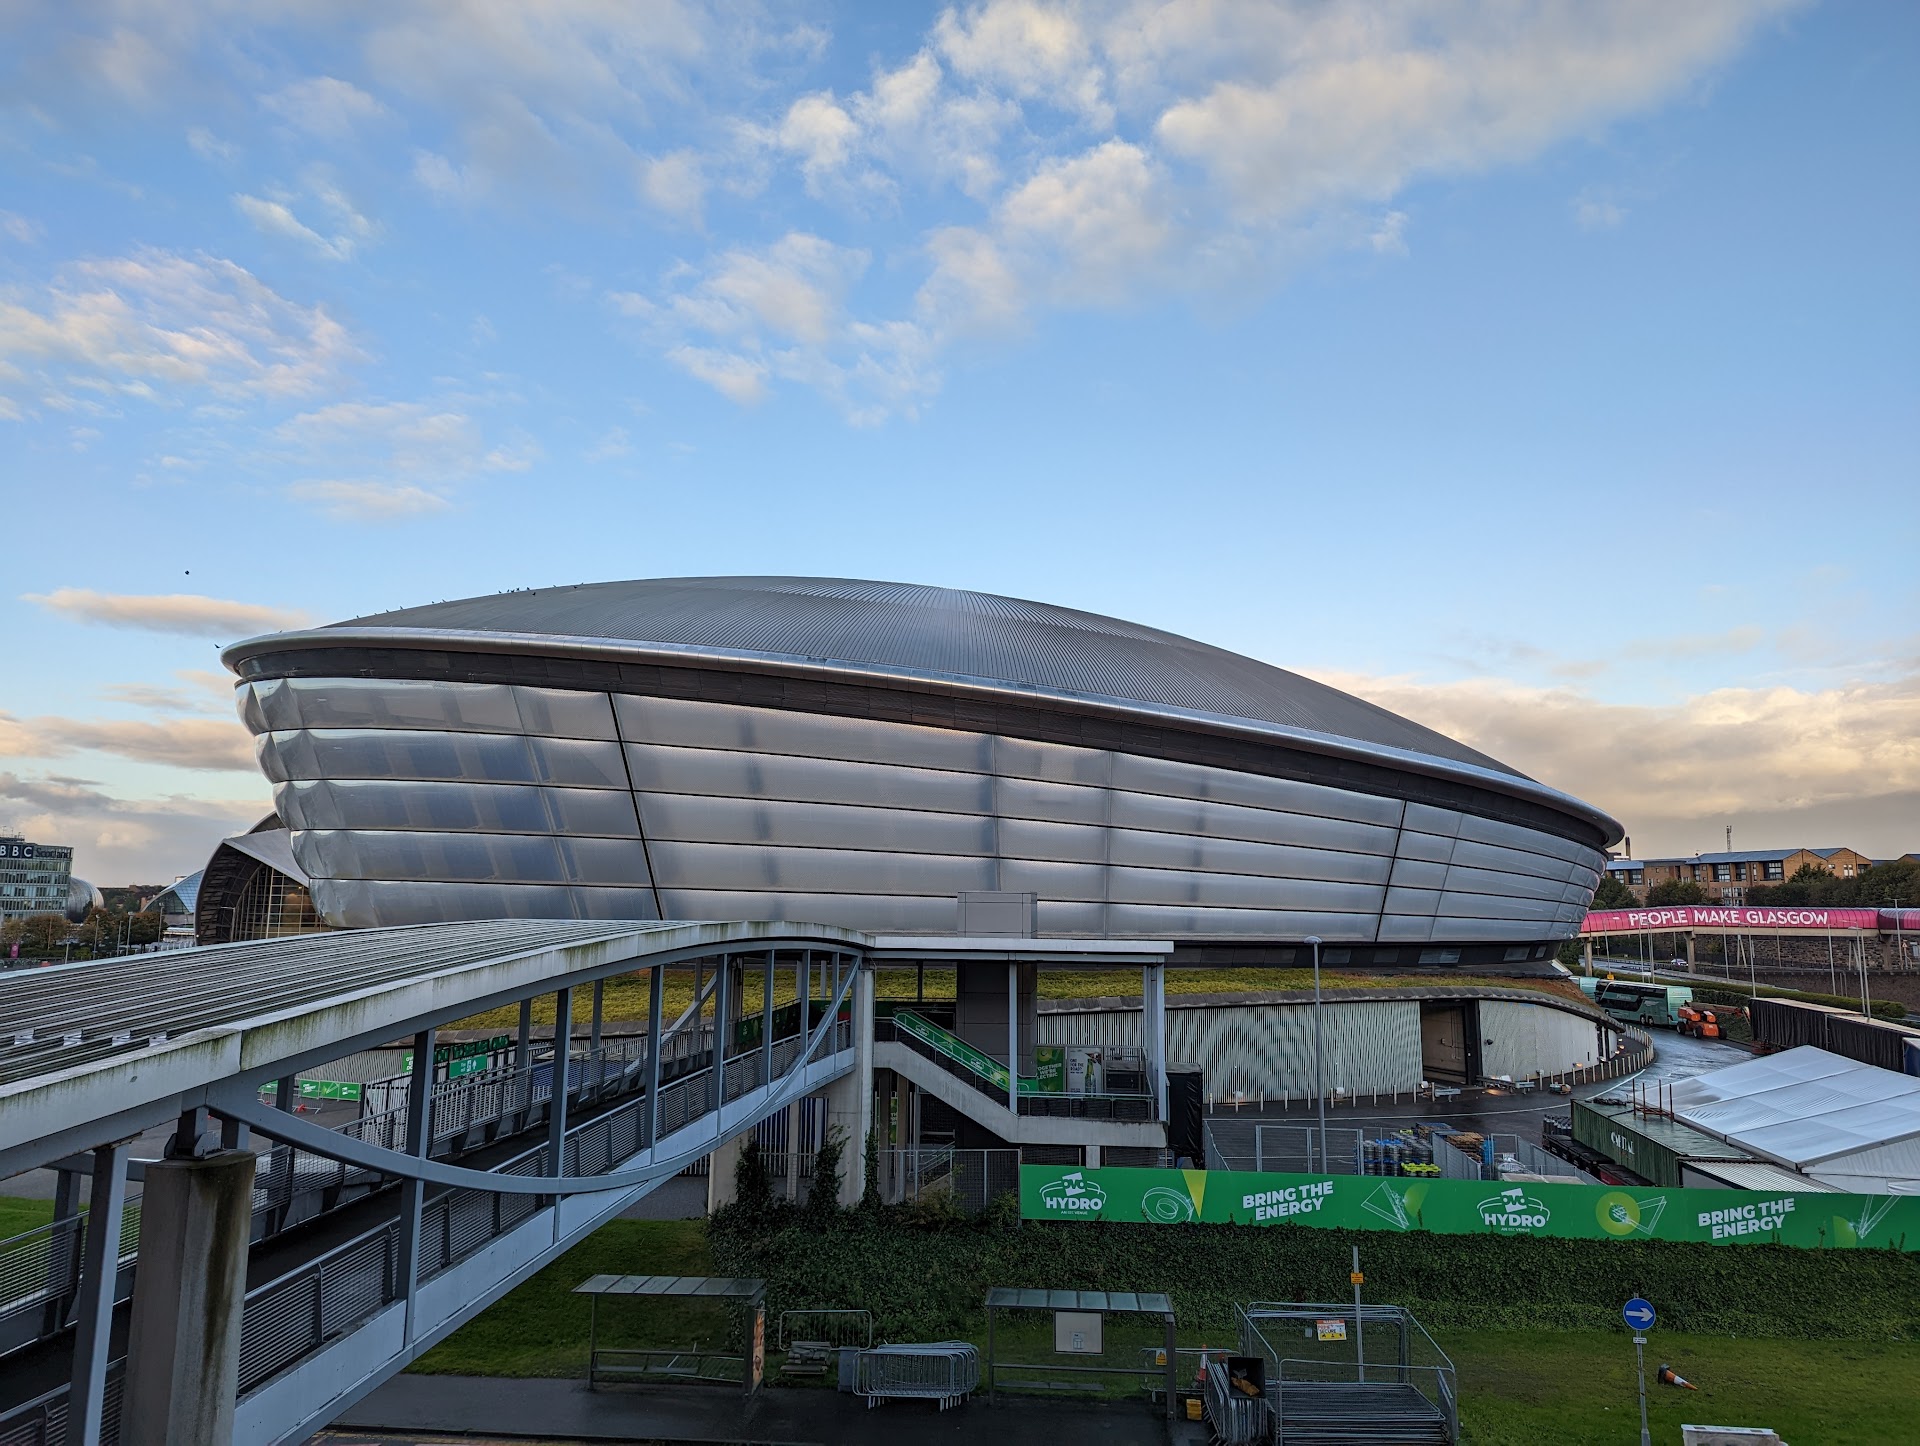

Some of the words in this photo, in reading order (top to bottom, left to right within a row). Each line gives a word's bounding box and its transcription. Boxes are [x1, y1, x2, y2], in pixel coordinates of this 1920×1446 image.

[0, 845, 32, 857] BBC
[1628, 910, 1688, 926] PEOPLE
[1694, 910, 1740, 924] MAKE
[1746, 910, 1828, 925] GLASGOW
[1037, 1063, 1062, 1071] OGETHER
[1036, 1072, 1058, 1080] LECTRIC
[1242, 1187, 1297, 1209] BRING
[1298, 1180, 1334, 1199] THE
[1045, 1196, 1103, 1211] HYDRO
[1255, 1196, 1325, 1221] ENERGY
[1698, 1204, 1756, 1227] BRING
[1757, 1197, 1796, 1216] THE
[1484, 1213, 1546, 1228] HYDRO
[1711, 1214, 1786, 1240] ENERGY
